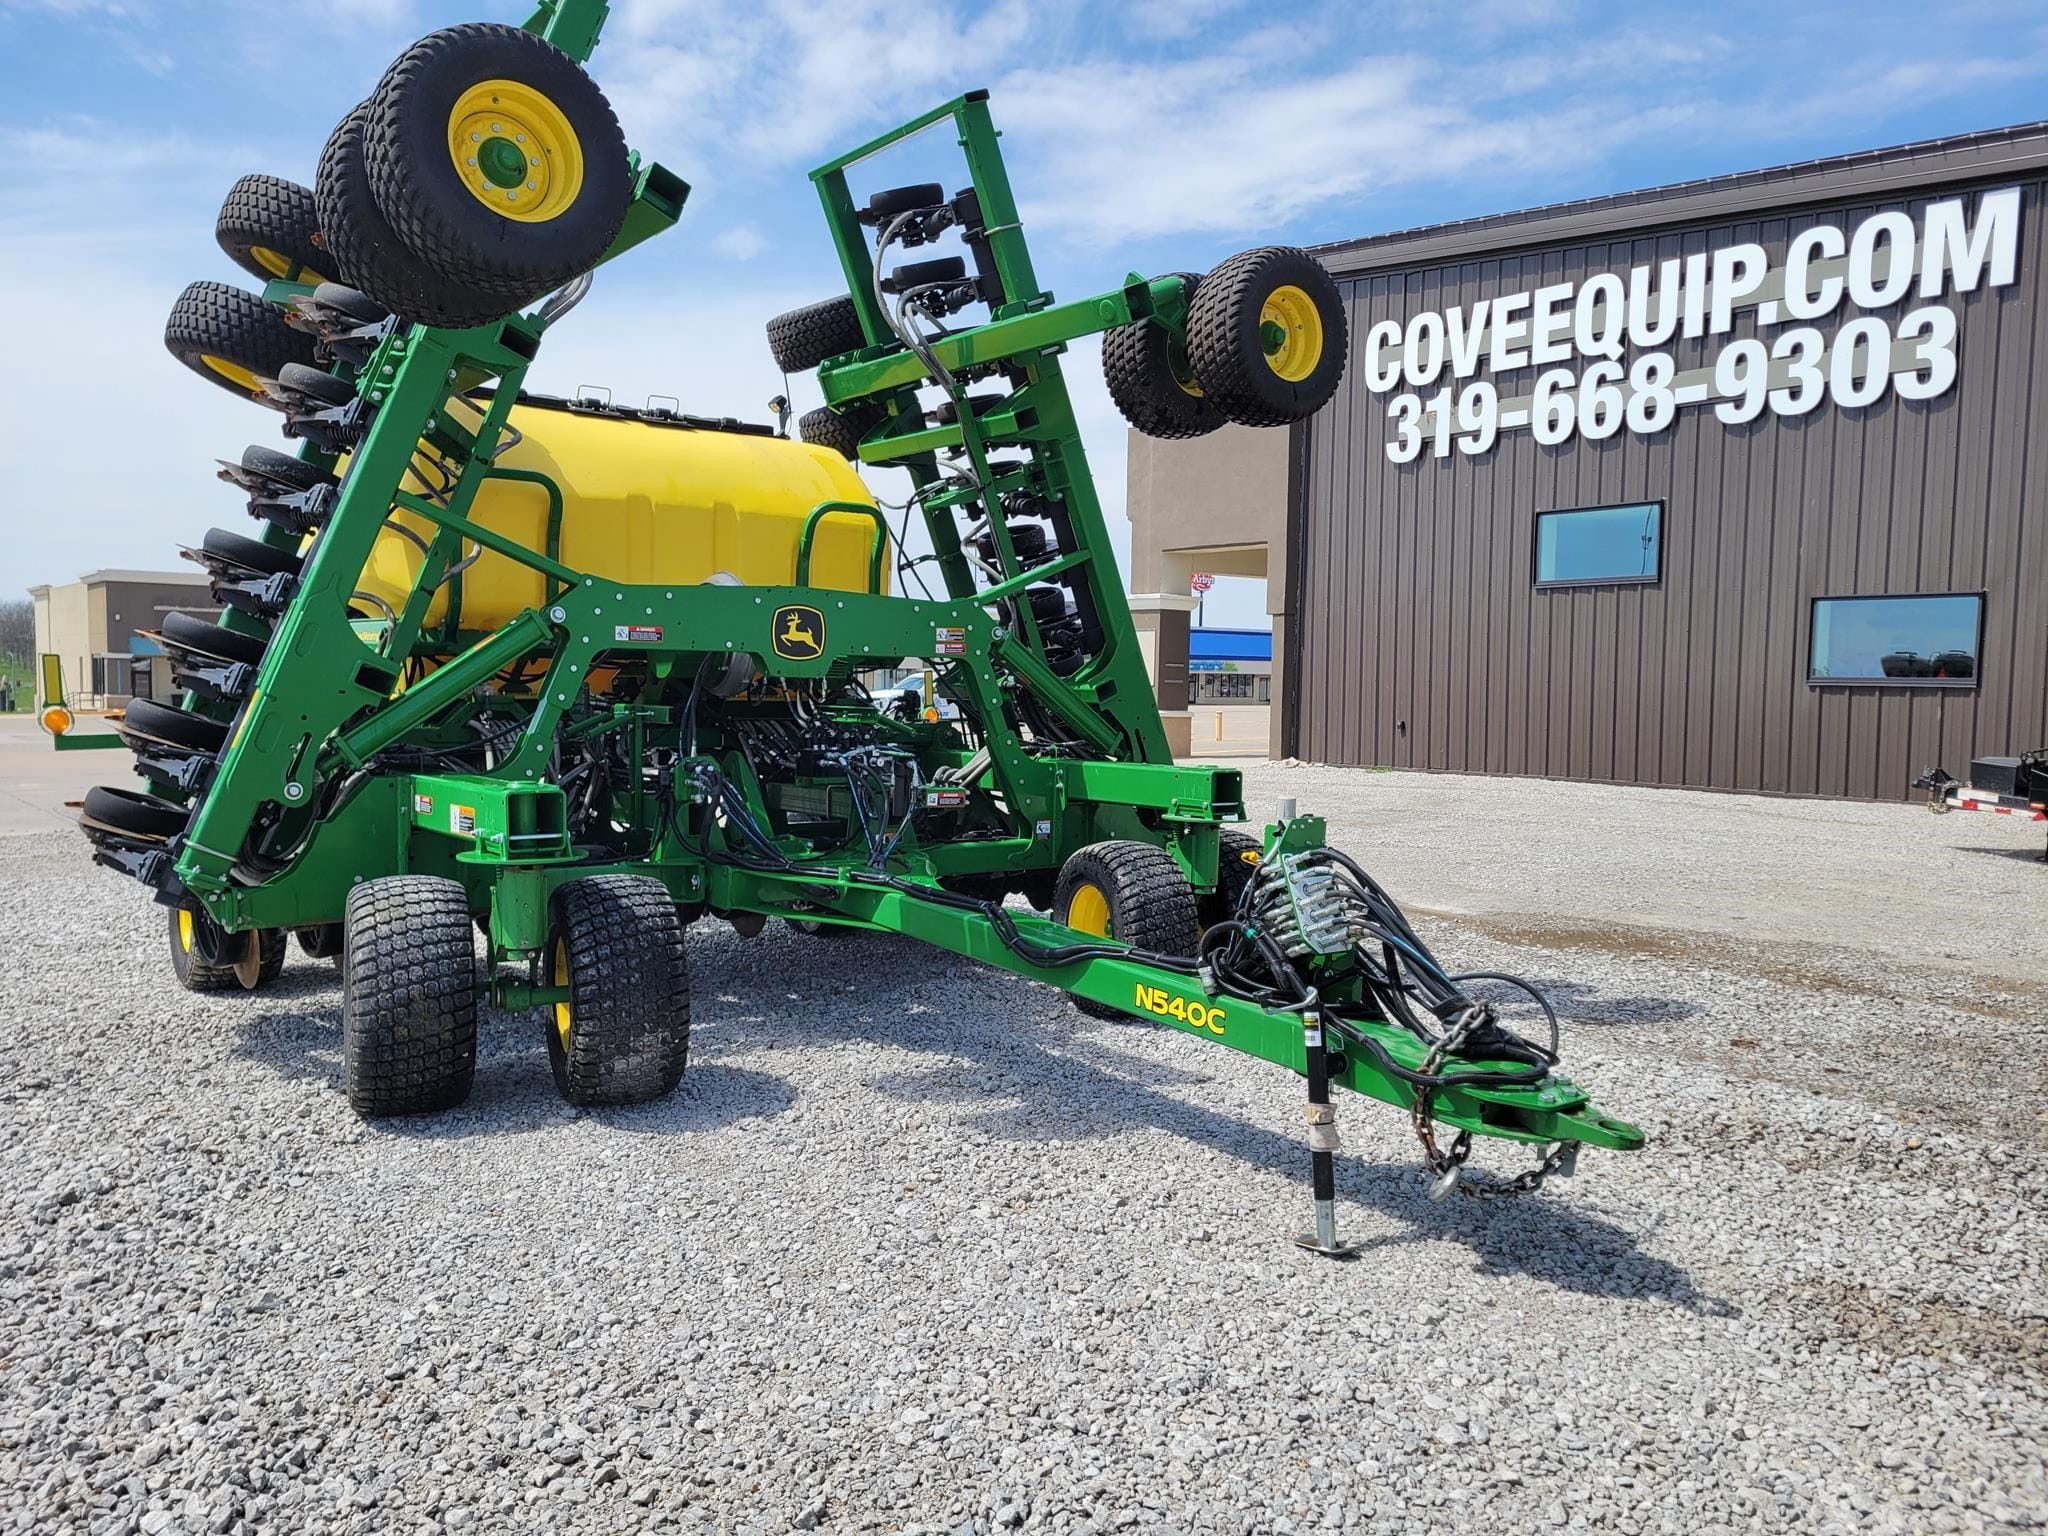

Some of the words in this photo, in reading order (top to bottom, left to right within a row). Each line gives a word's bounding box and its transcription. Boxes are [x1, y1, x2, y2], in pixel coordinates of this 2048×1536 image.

[1364, 187, 2020, 393] COVEEQUIP.COM
[1386, 306, 1957, 463] 319-668-9303
[1135, 983, 1226, 1035] N540C
